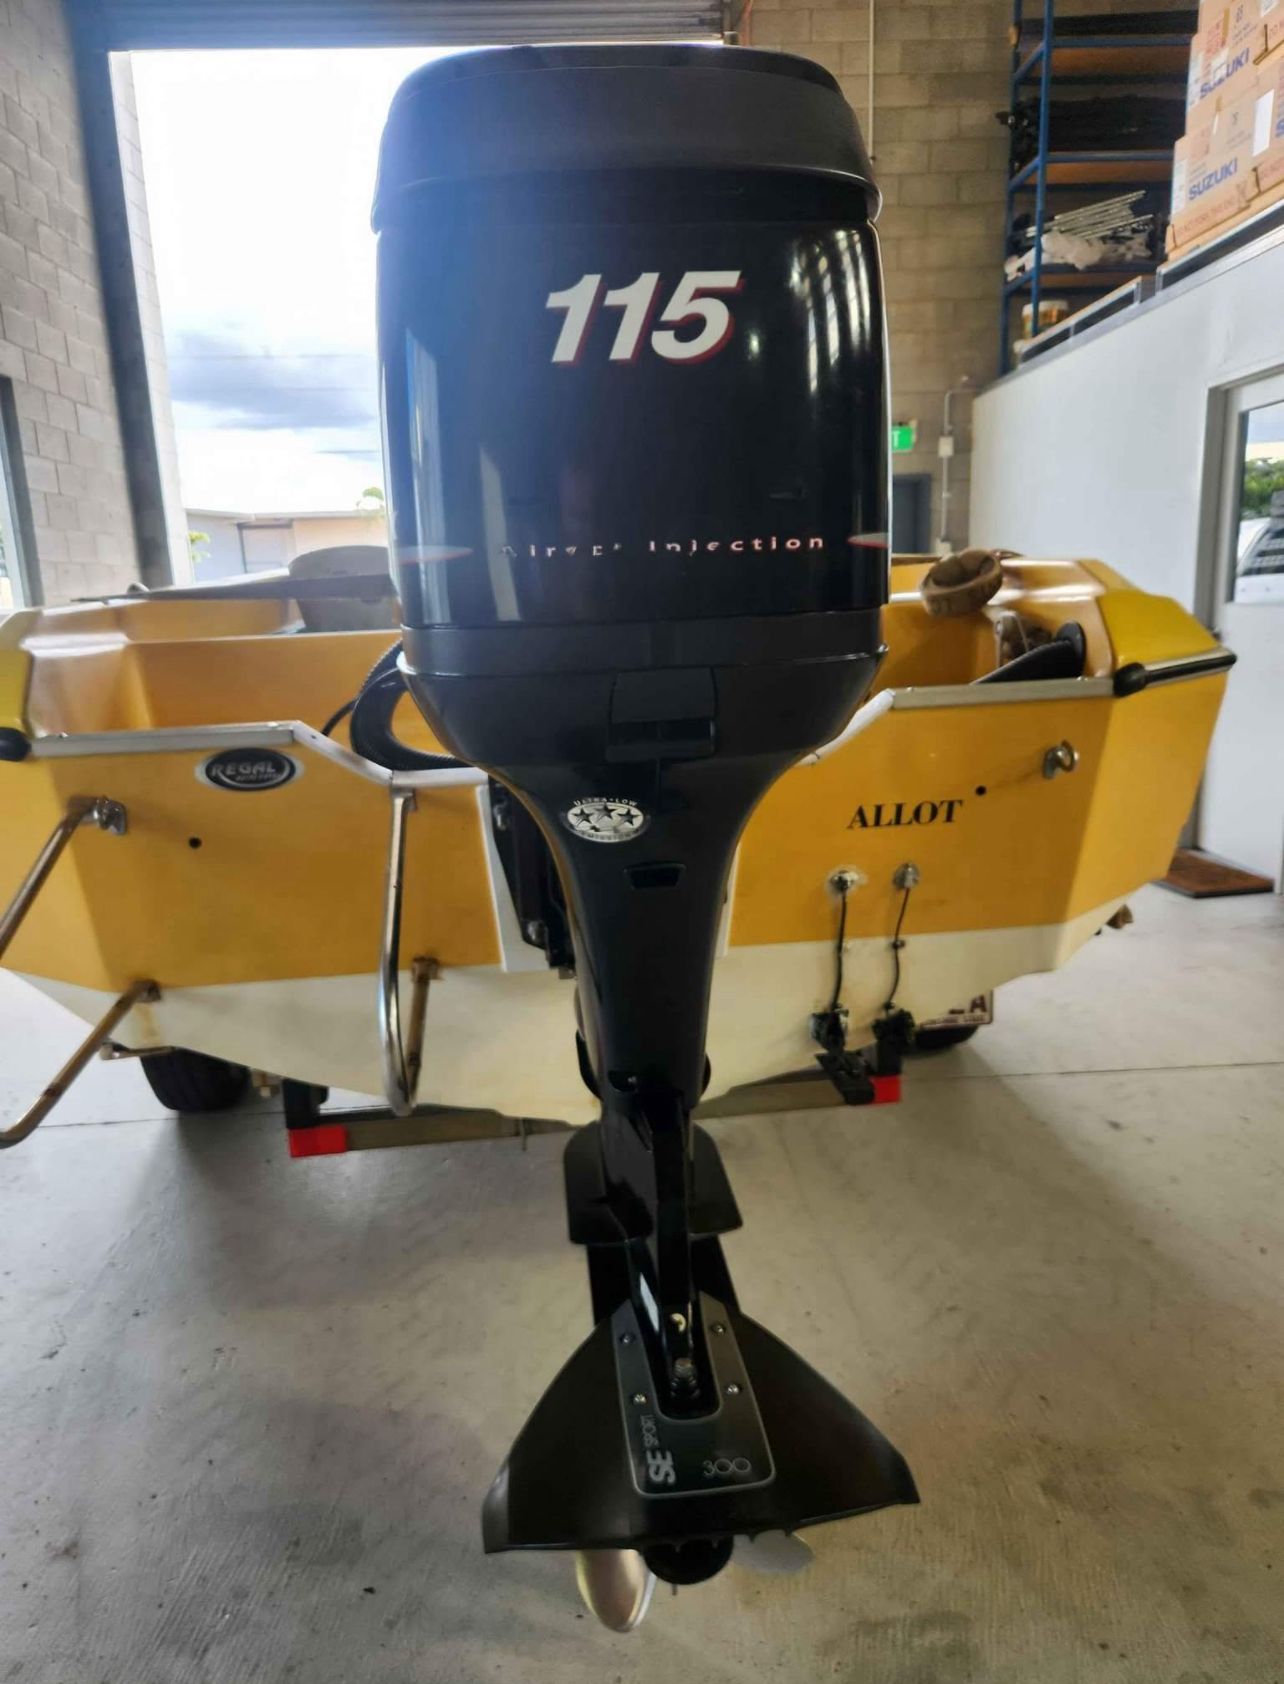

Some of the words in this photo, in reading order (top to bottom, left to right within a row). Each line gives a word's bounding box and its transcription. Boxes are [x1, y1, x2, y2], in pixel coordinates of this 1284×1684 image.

[1188, 157, 1238, 200] SUZUKI
[546, 270, 744, 366] 115
[501, 541, 623, 558] irec
[211, 761, 276, 776] REGAL
[846, 799, 963, 829] ALLOT
[646, 1450, 676, 1484] SE
[703, 1457, 752, 1476] 300
